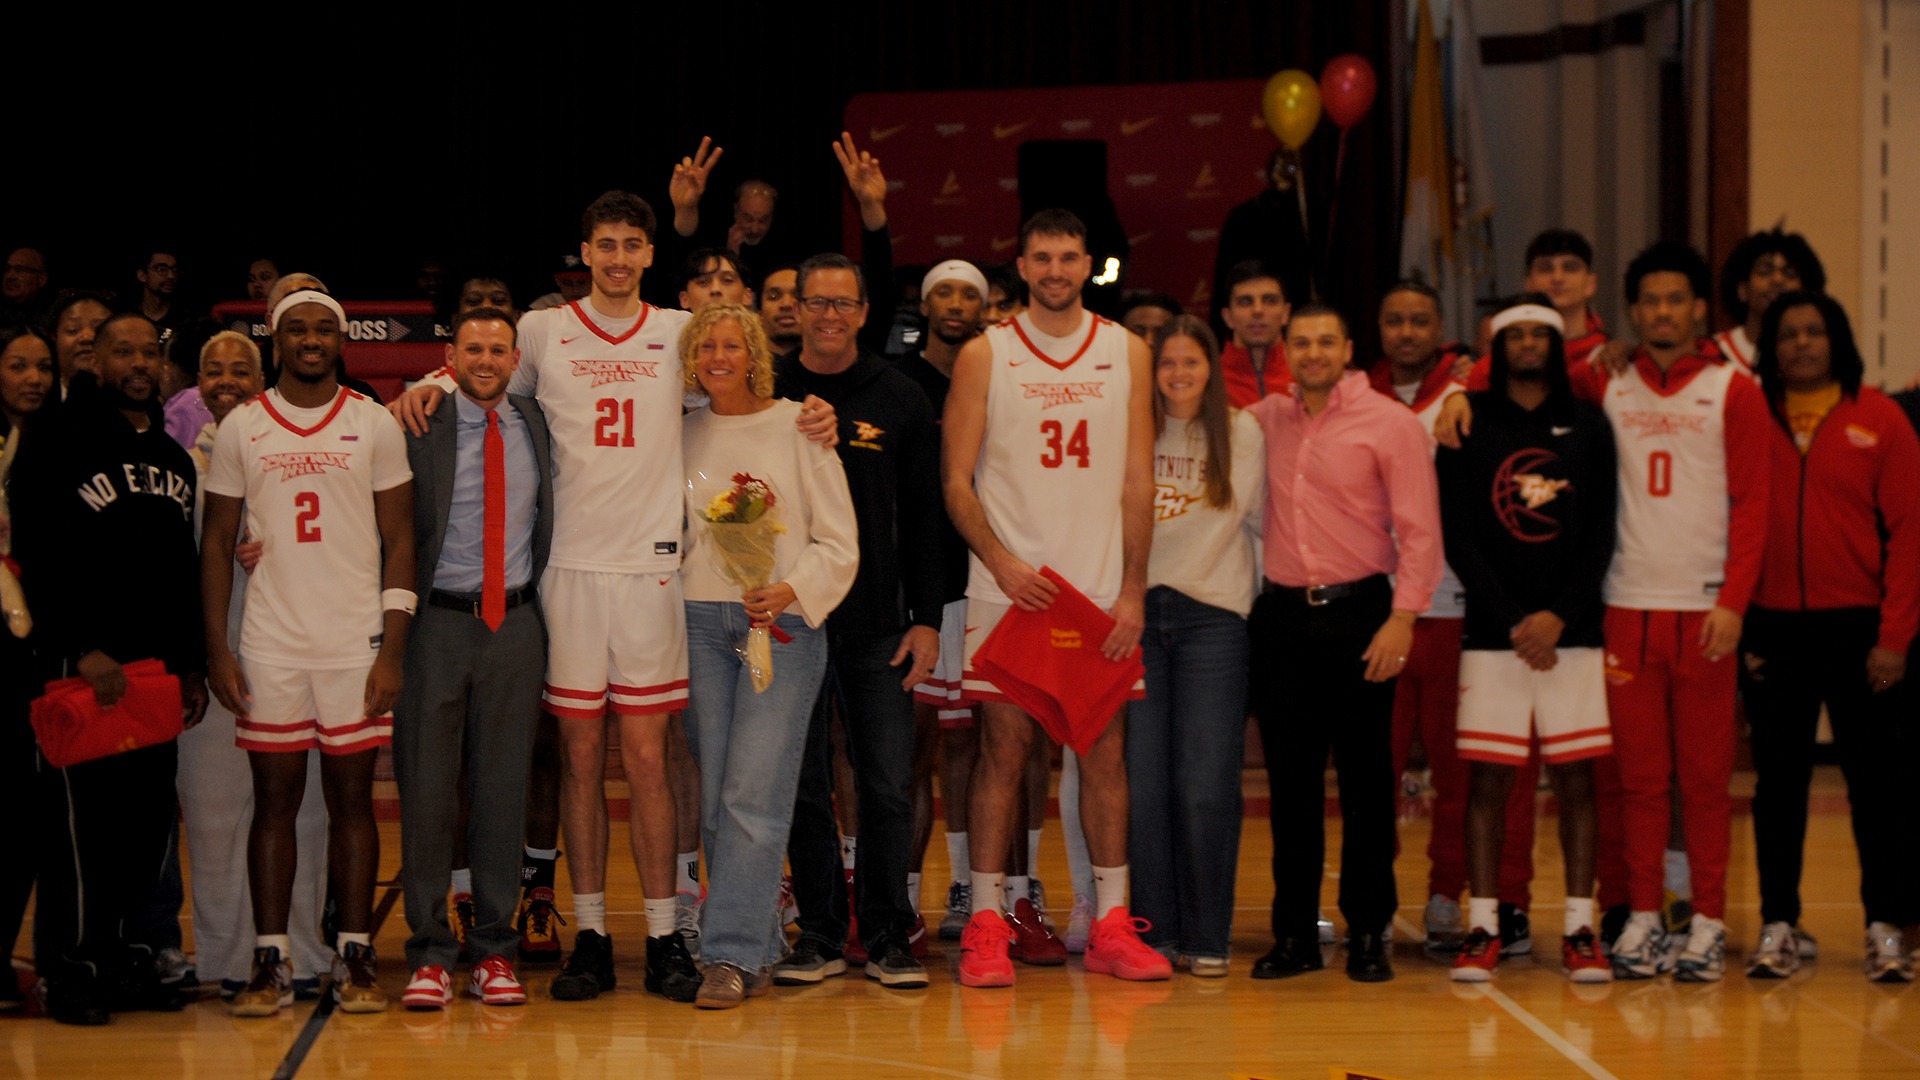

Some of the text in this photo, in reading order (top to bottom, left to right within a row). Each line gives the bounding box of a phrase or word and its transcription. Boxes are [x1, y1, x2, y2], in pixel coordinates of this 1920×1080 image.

[595, 398, 635, 447] 21
[1040, 419, 1089, 468] 34
[77, 472, 118, 512] NO
[1648, 451, 1671, 497] 0
[295, 492, 321, 543] 2
